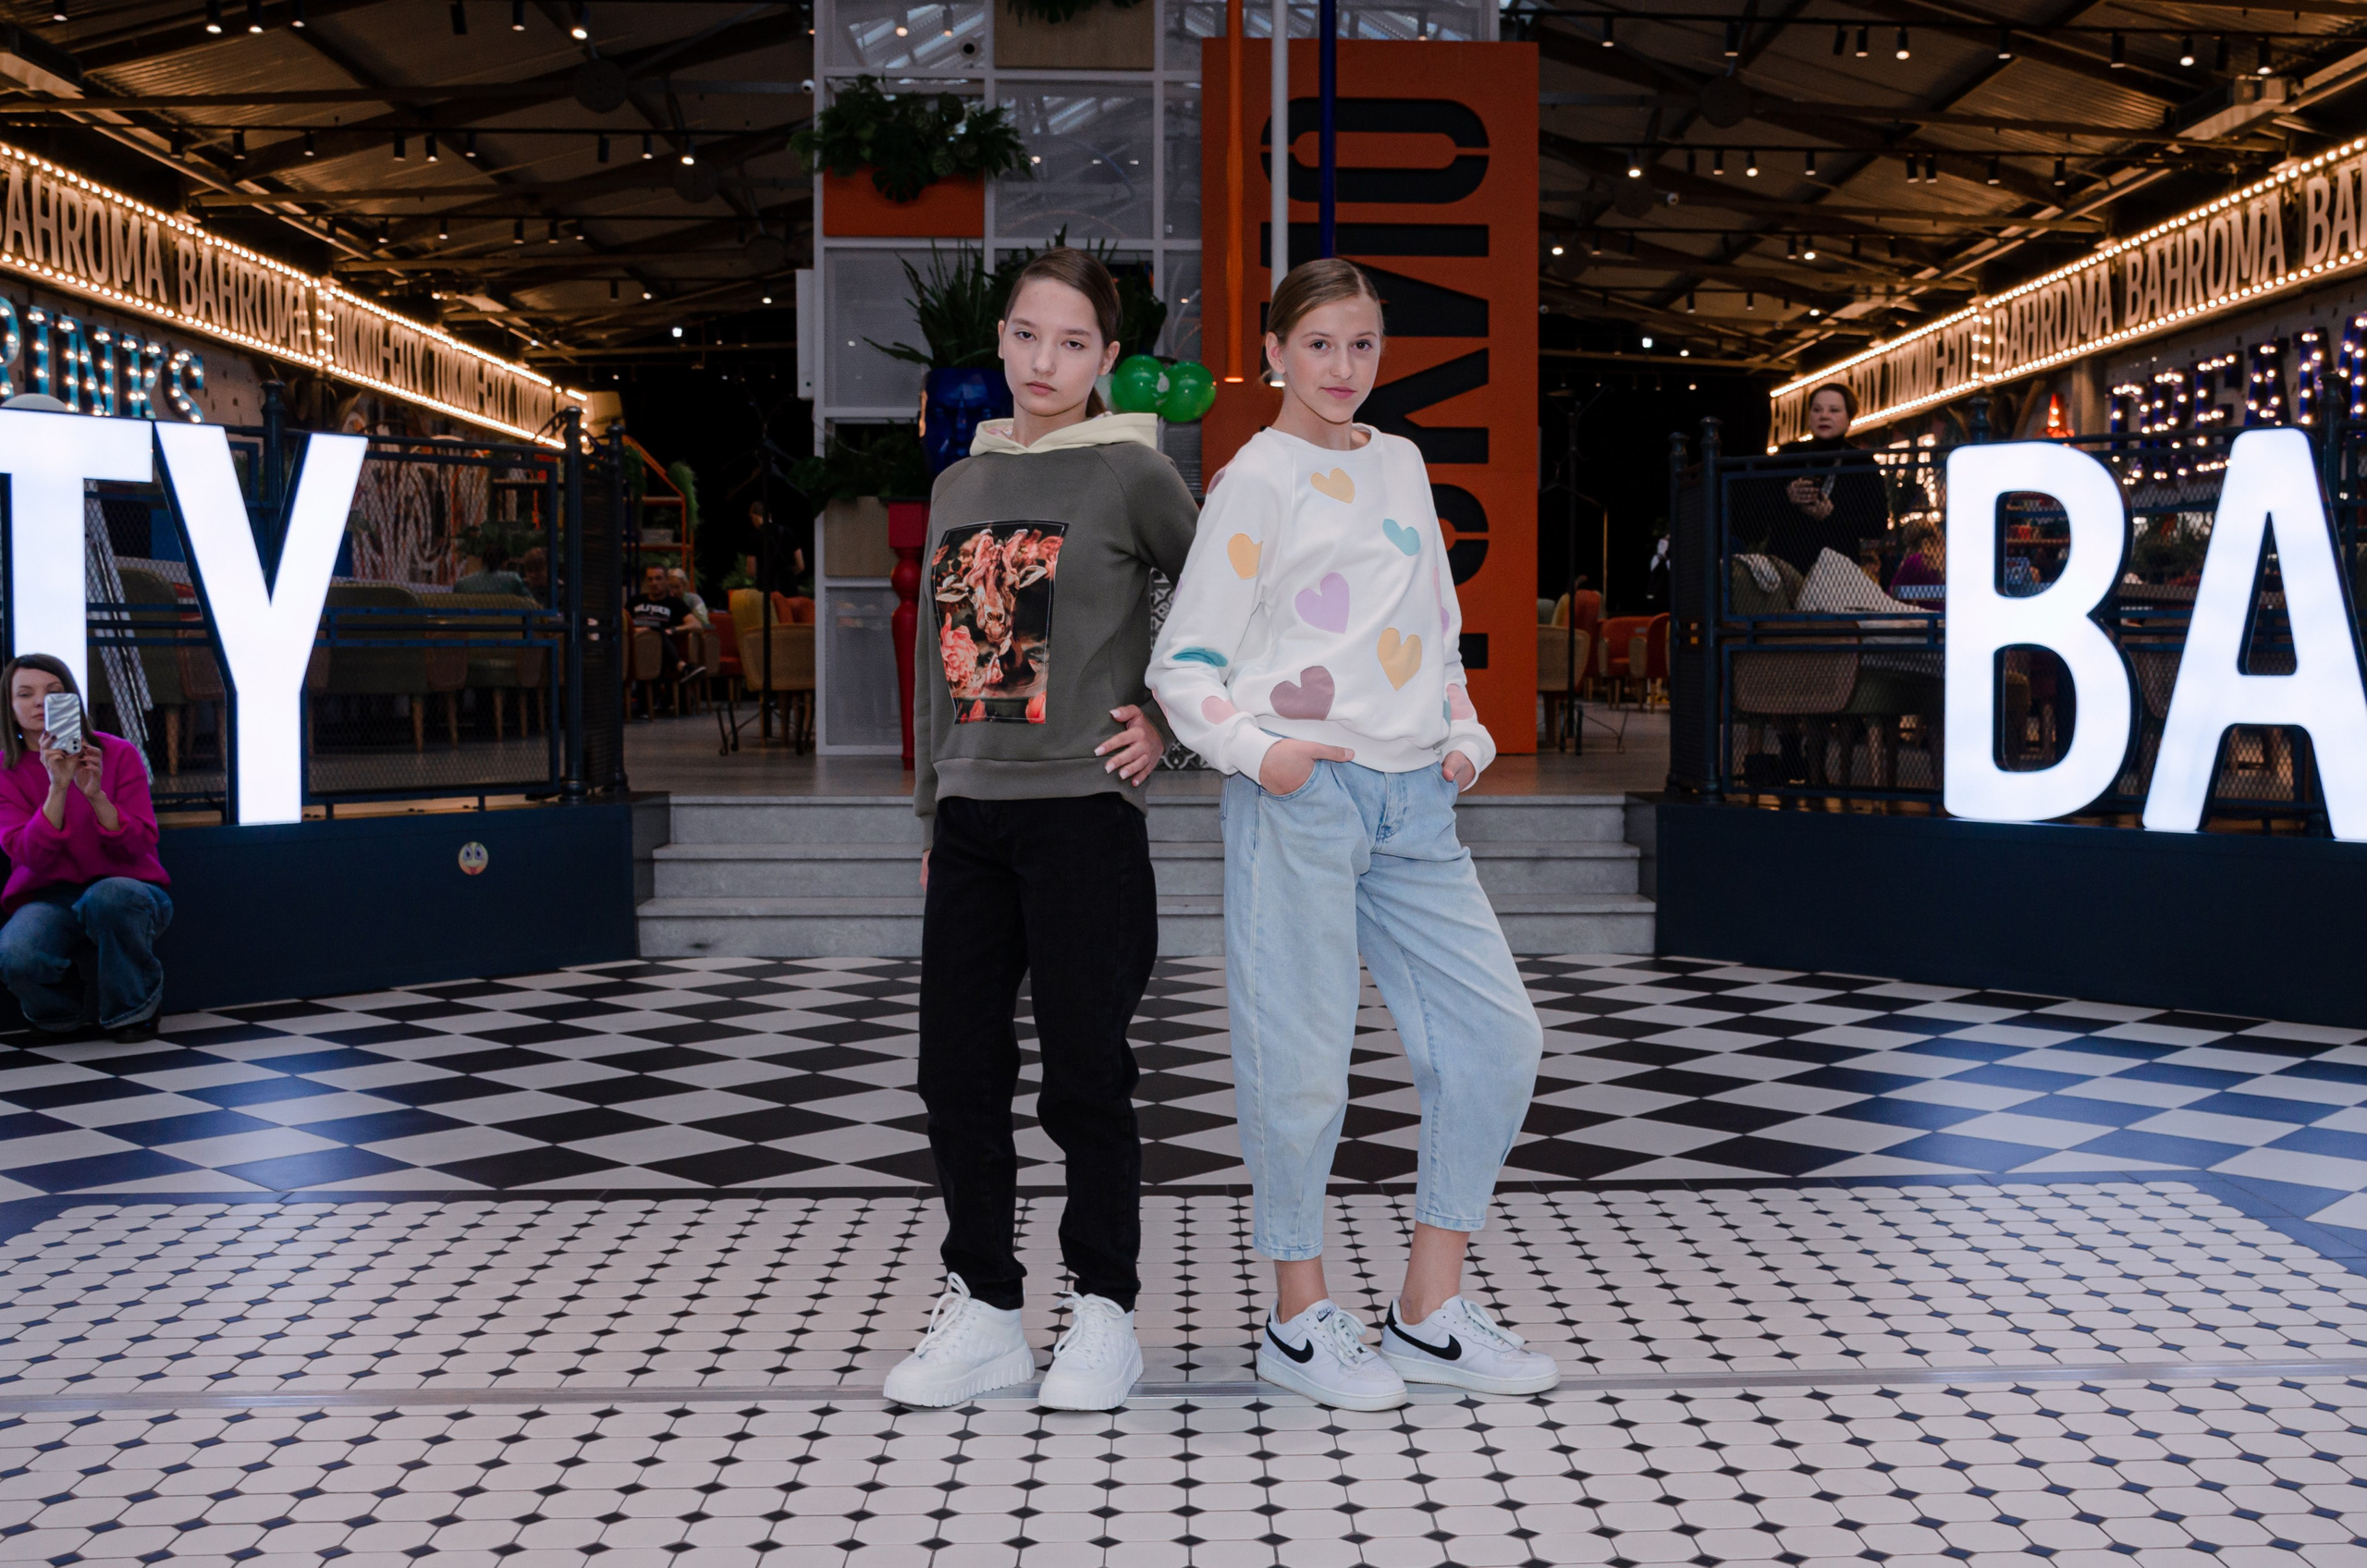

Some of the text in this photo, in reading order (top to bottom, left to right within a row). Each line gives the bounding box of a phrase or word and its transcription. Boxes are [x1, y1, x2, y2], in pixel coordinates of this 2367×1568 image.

[0, 165, 314, 356] AHROMA BAHROMA
[1993, 262, 2114, 374] BAHROMA
[2125, 192, 2287, 327] BAHROMA
[0, 409, 368, 826] TY
[1944, 428, 2367, 842] BA
